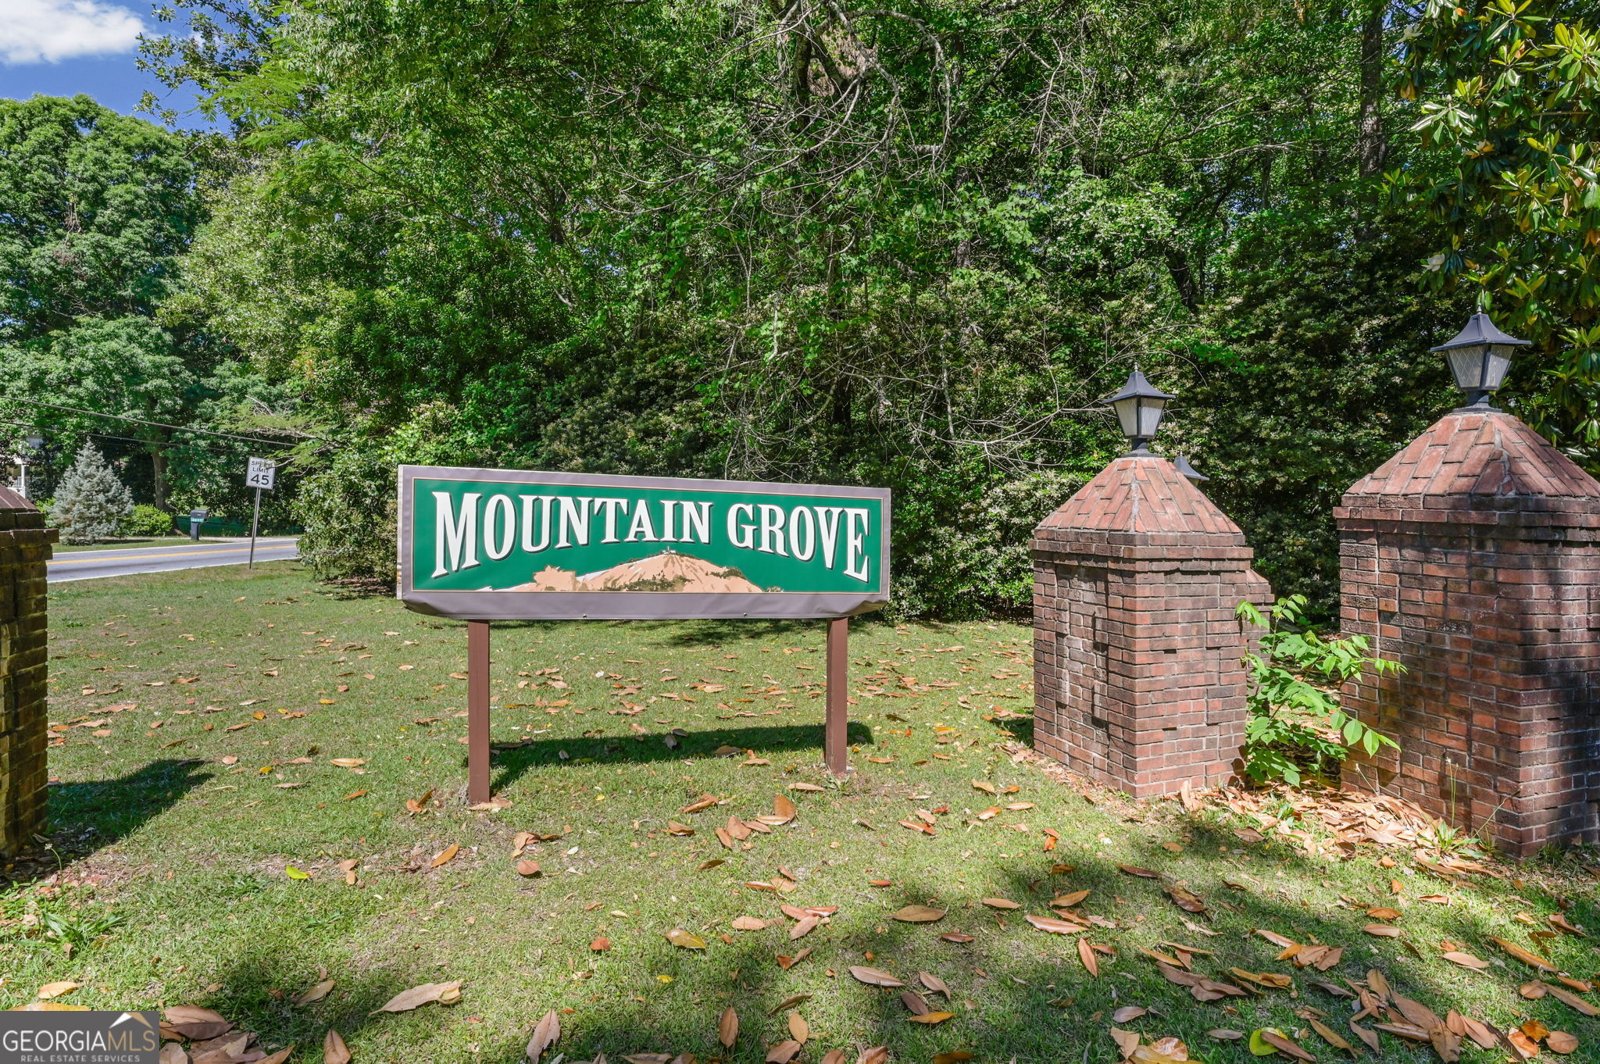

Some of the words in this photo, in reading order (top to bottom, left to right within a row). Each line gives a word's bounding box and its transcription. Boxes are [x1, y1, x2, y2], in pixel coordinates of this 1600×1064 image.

[250, 474, 269, 485] 45
[431, 491, 714, 579] MOUNTAIN
[727, 502, 870, 583] GROVE
